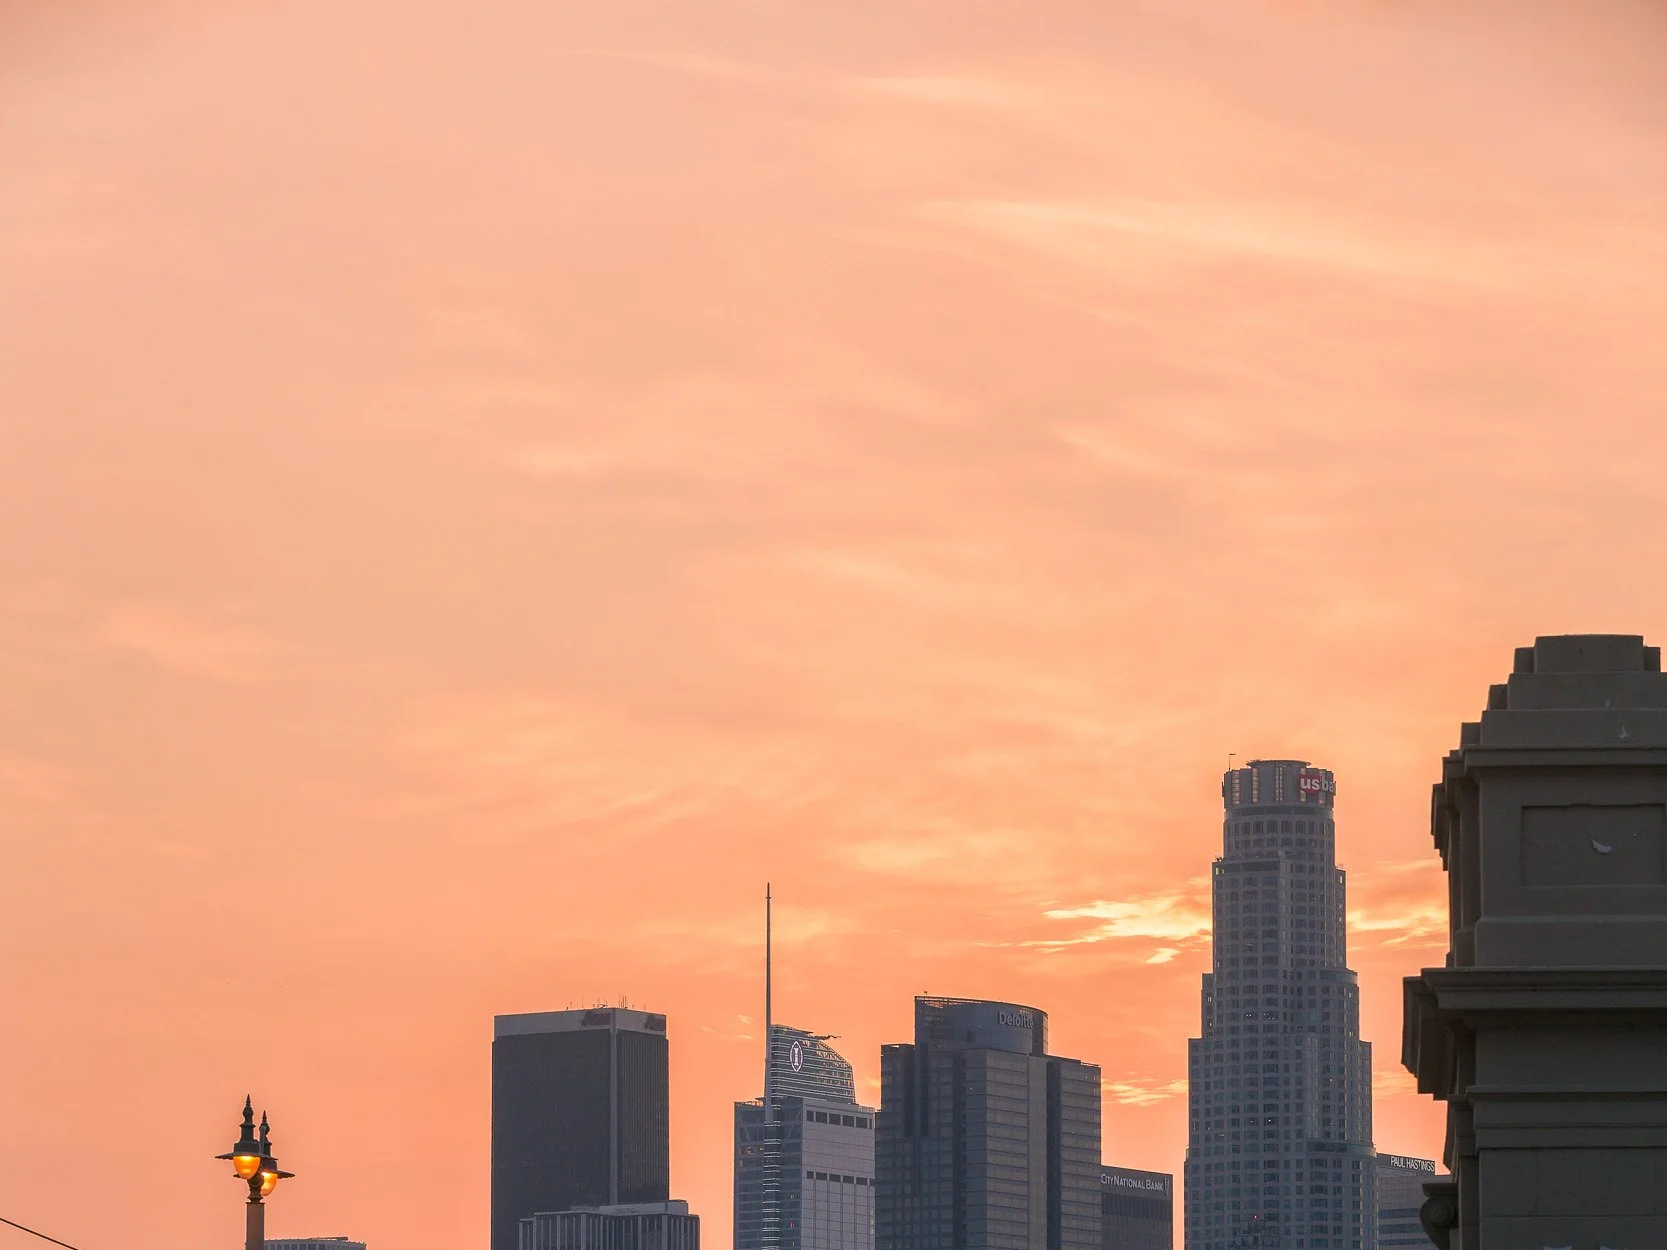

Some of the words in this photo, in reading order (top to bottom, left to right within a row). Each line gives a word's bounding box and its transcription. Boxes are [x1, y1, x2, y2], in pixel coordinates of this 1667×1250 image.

[999, 1011, 1034, 1029] Deloitte
[1390, 1156, 1405, 1168] PAUL
[1406, 1158, 1435, 1172] HASTINGS
[1145, 1179, 1164, 1192] BANK
